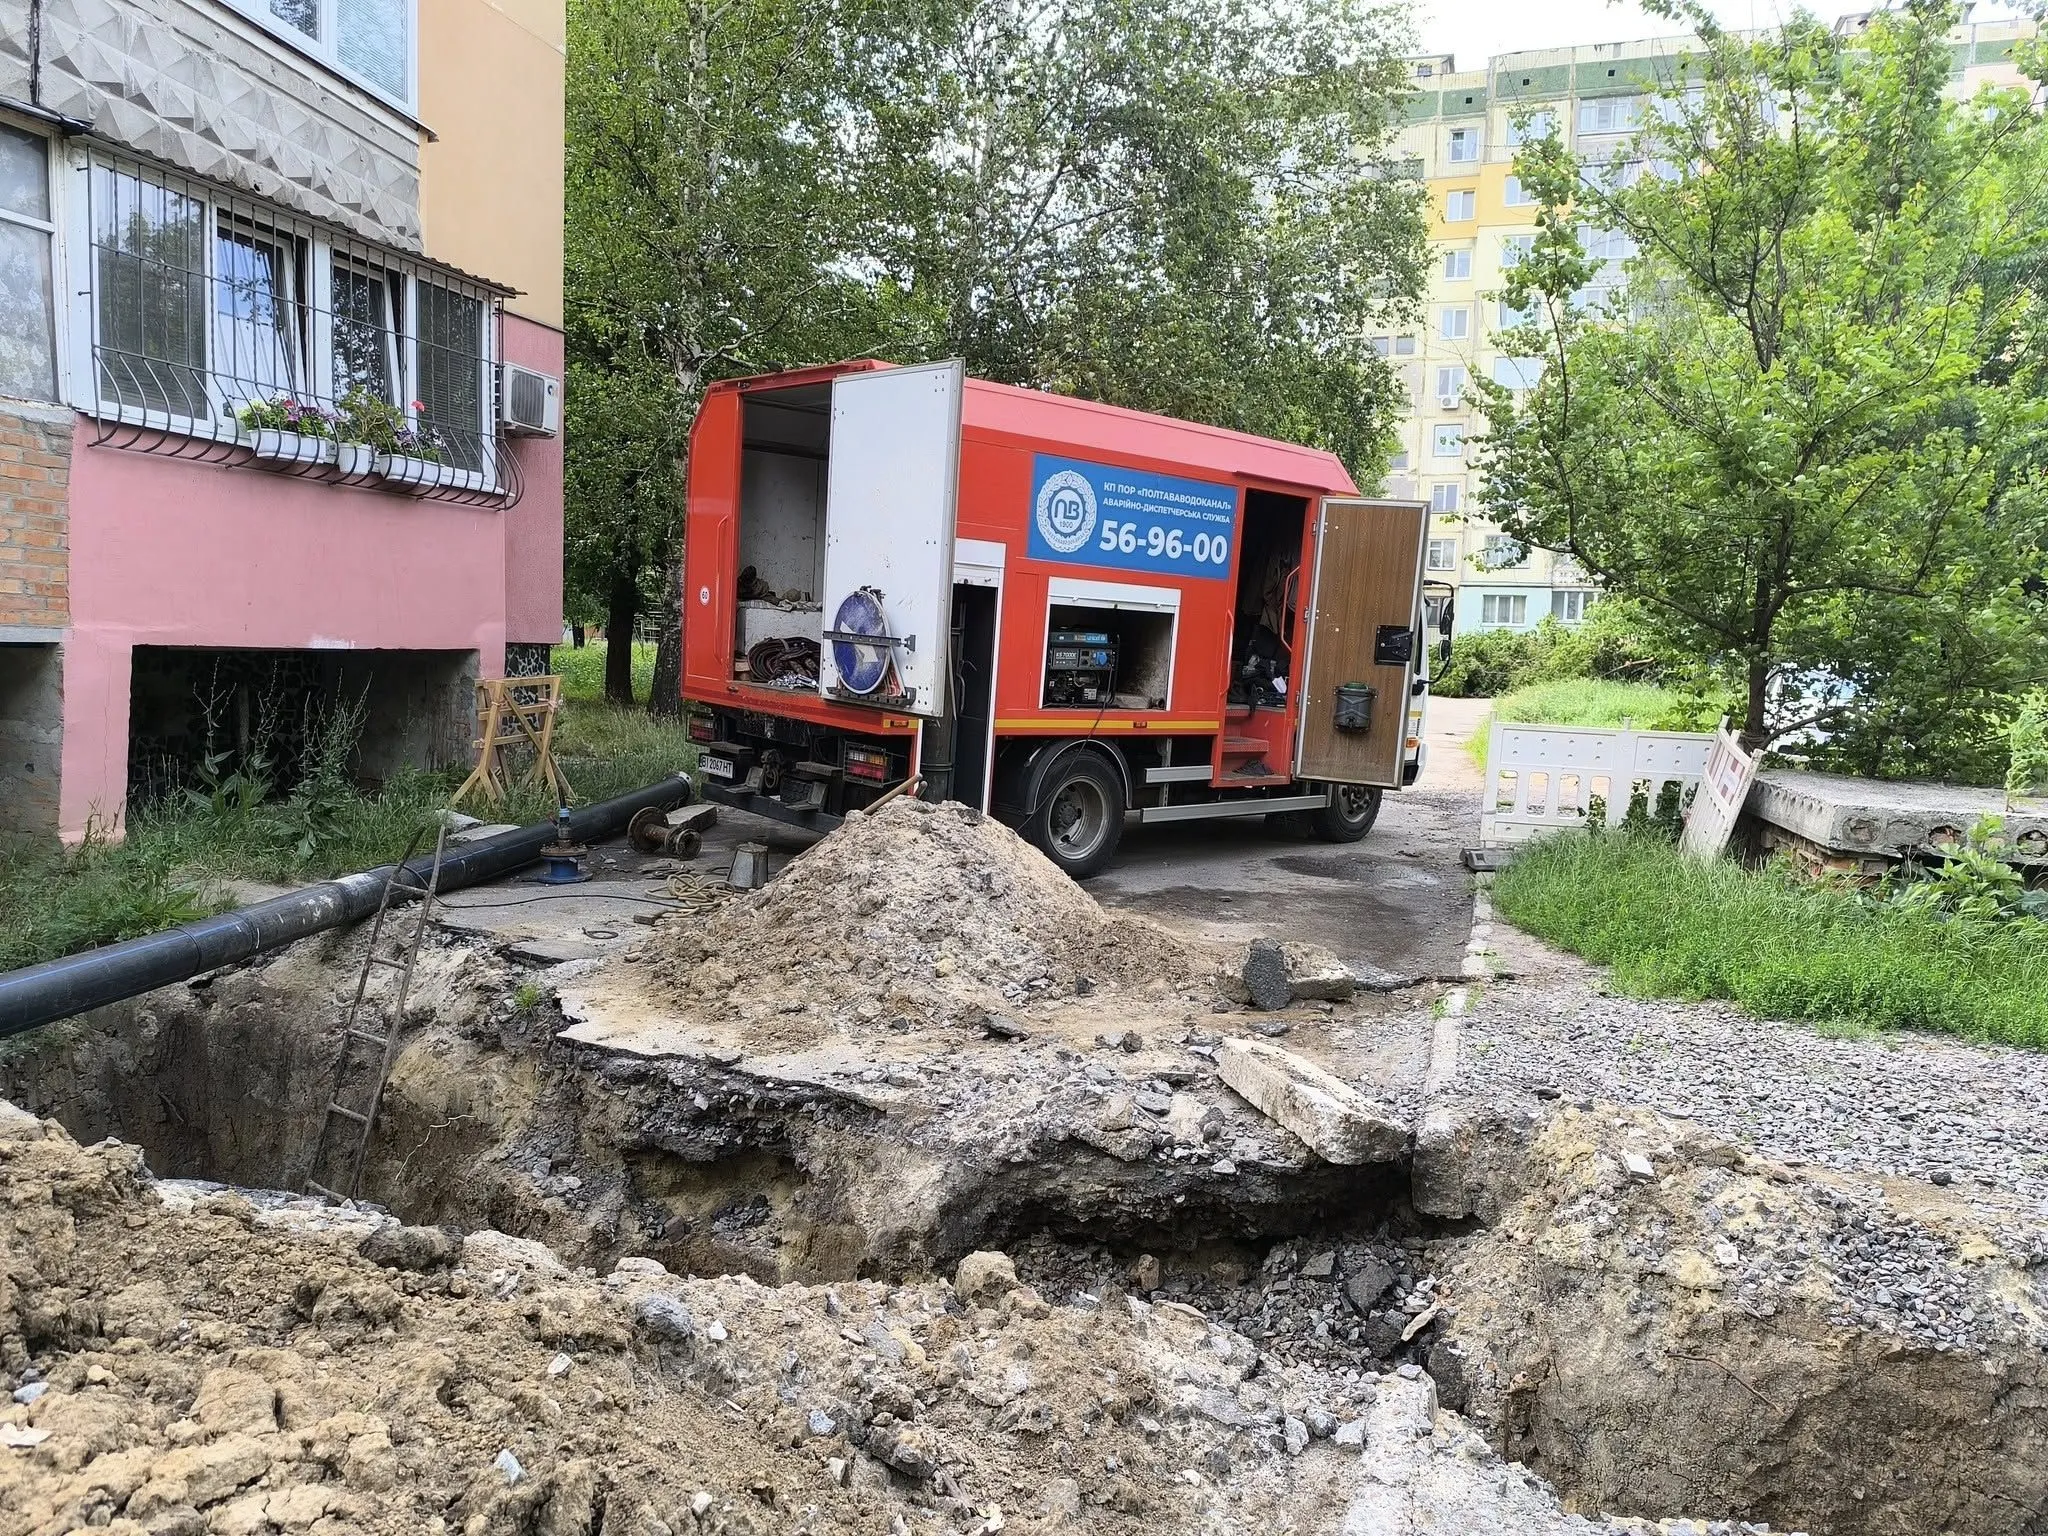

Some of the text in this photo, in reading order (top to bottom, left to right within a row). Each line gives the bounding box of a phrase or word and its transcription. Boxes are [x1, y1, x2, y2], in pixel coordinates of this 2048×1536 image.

[1103, 481, 1232, 510] КП ПОР «ПОЛТАВАВОДОКАНАЛ»
[1103, 497, 1231, 524] АВАРІЙНО-ДИСПЕТЧЕРСЬКА СЛУЖБА
[1099, 519, 1228, 565] 56-96-00
[723, 761, 732, 773] HT
